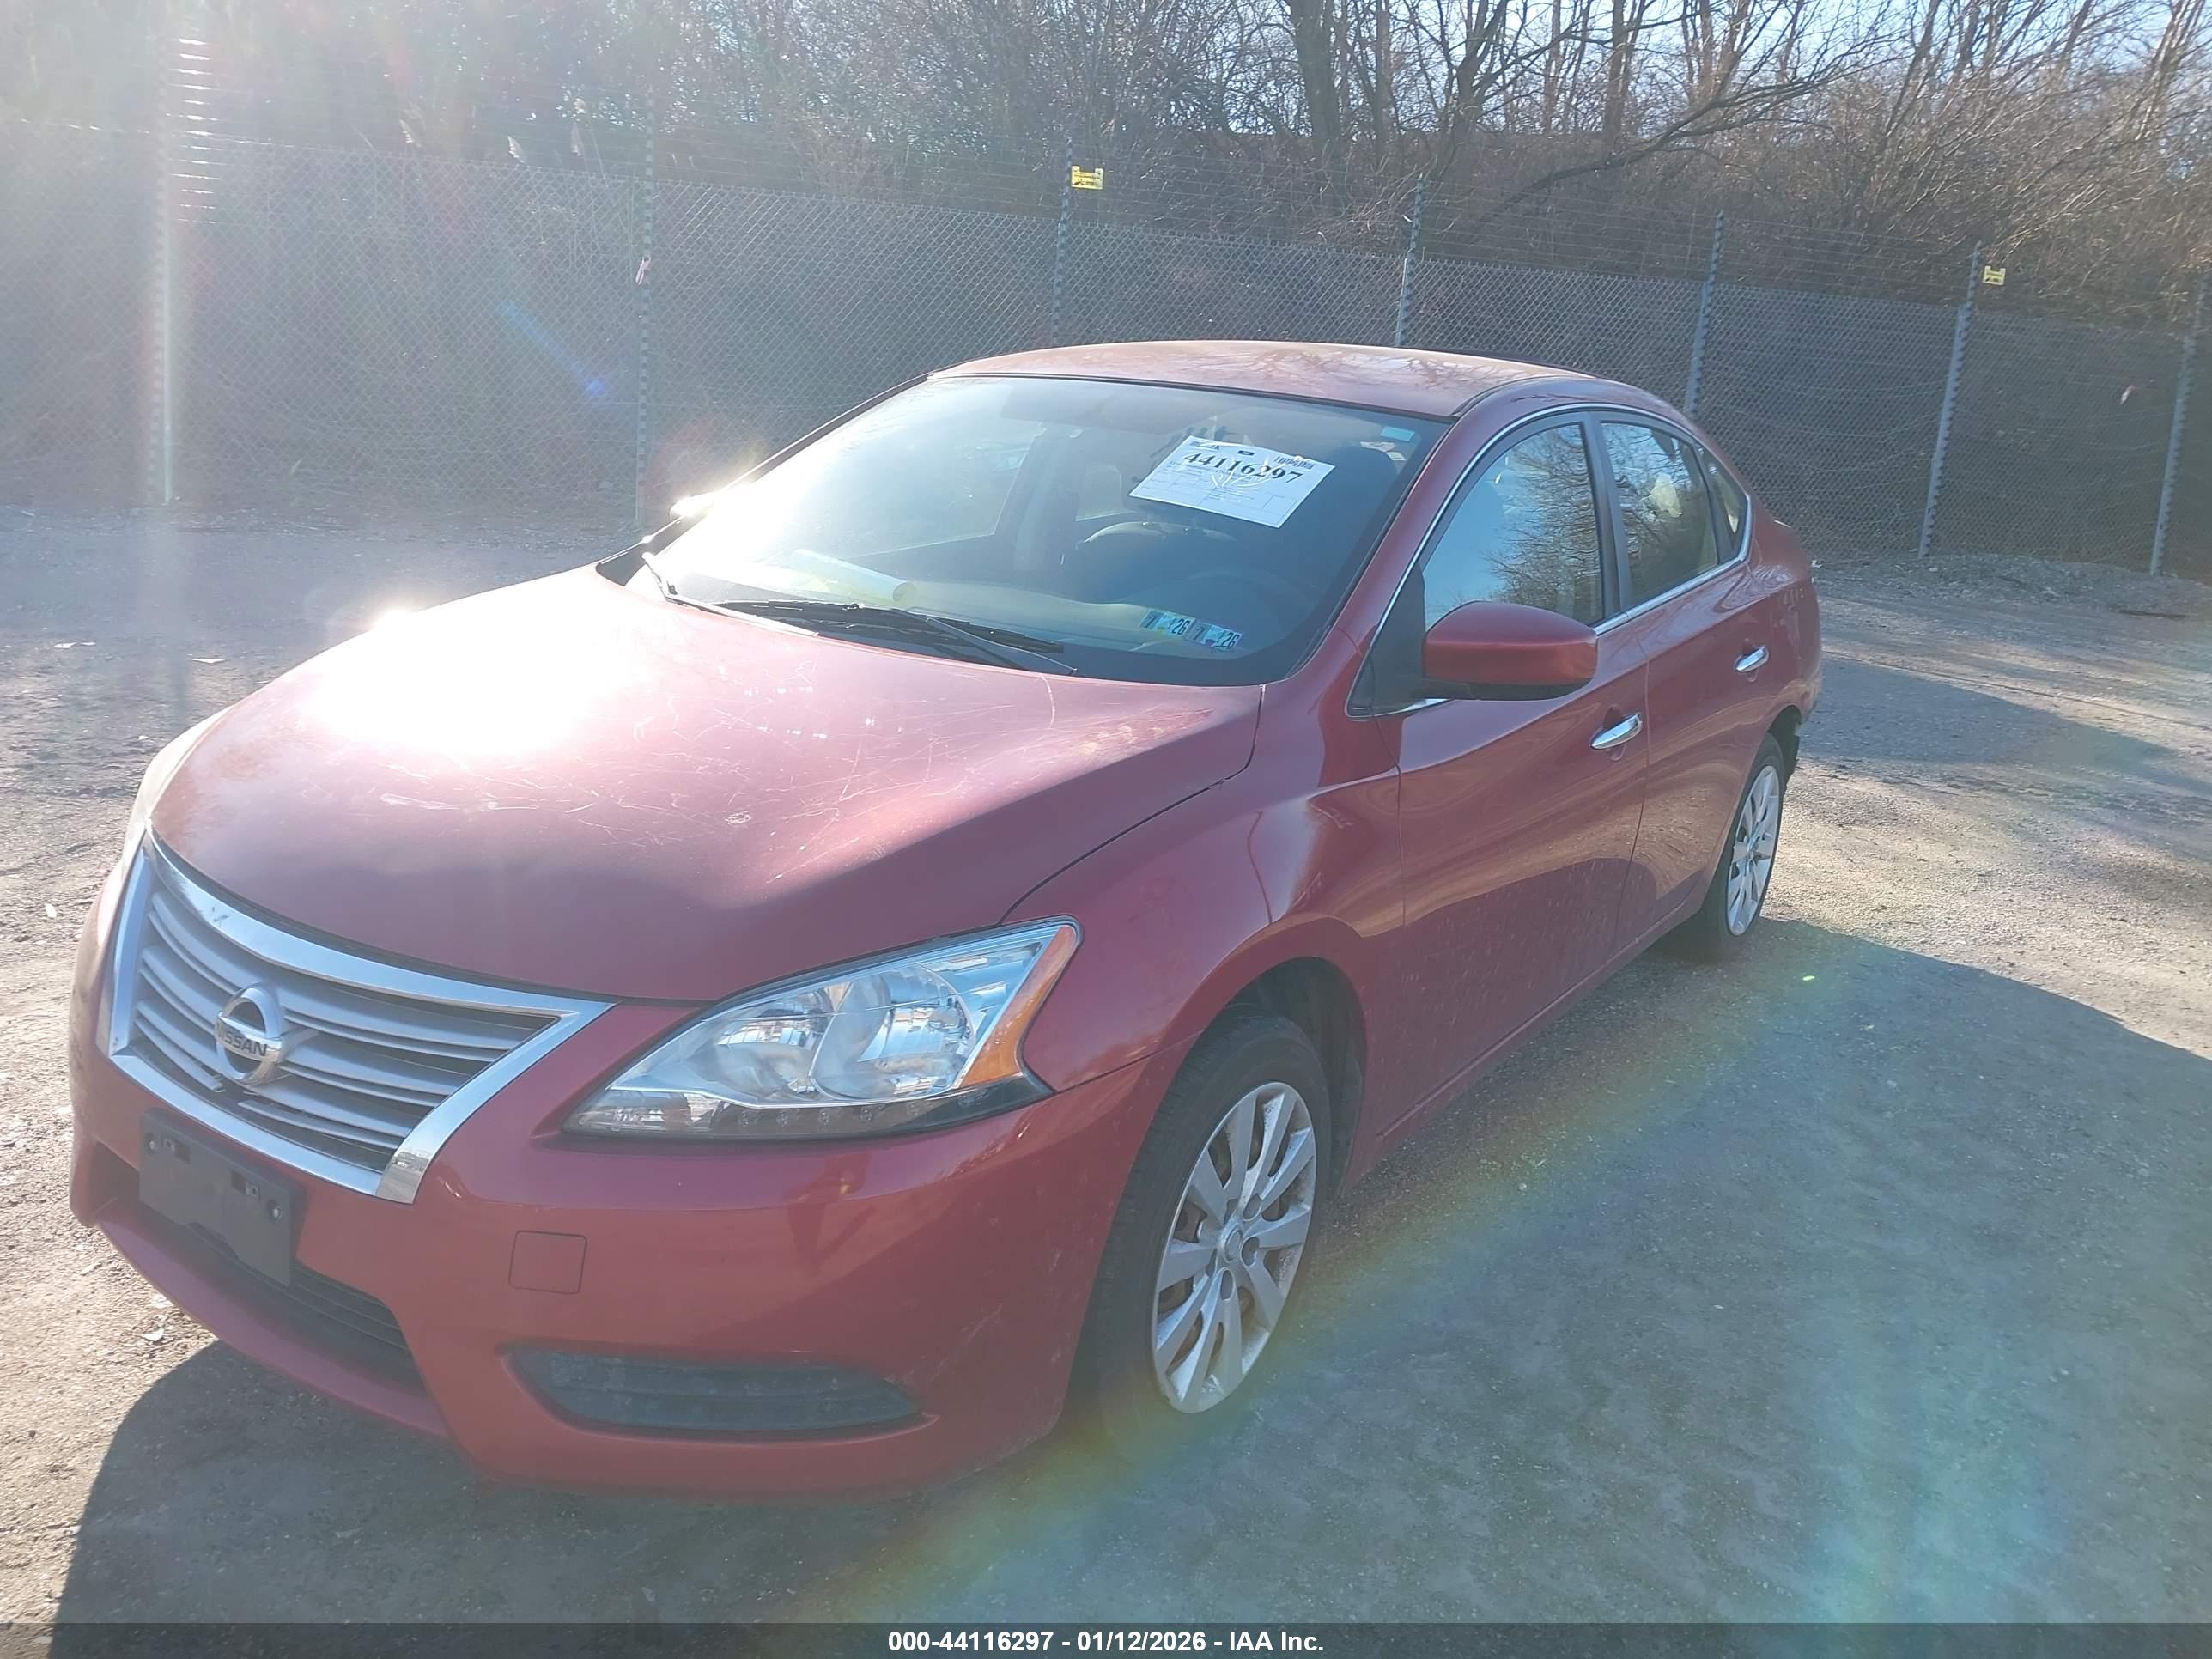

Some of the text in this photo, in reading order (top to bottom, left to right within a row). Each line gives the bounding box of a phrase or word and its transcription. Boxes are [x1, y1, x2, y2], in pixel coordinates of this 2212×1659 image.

[1183, 453, 1304, 483] 44116297
[1171, 618, 1191, 635] 26
[1221, 633, 1241, 647] 26
[216, 1021, 268, 1057] NISSAN
